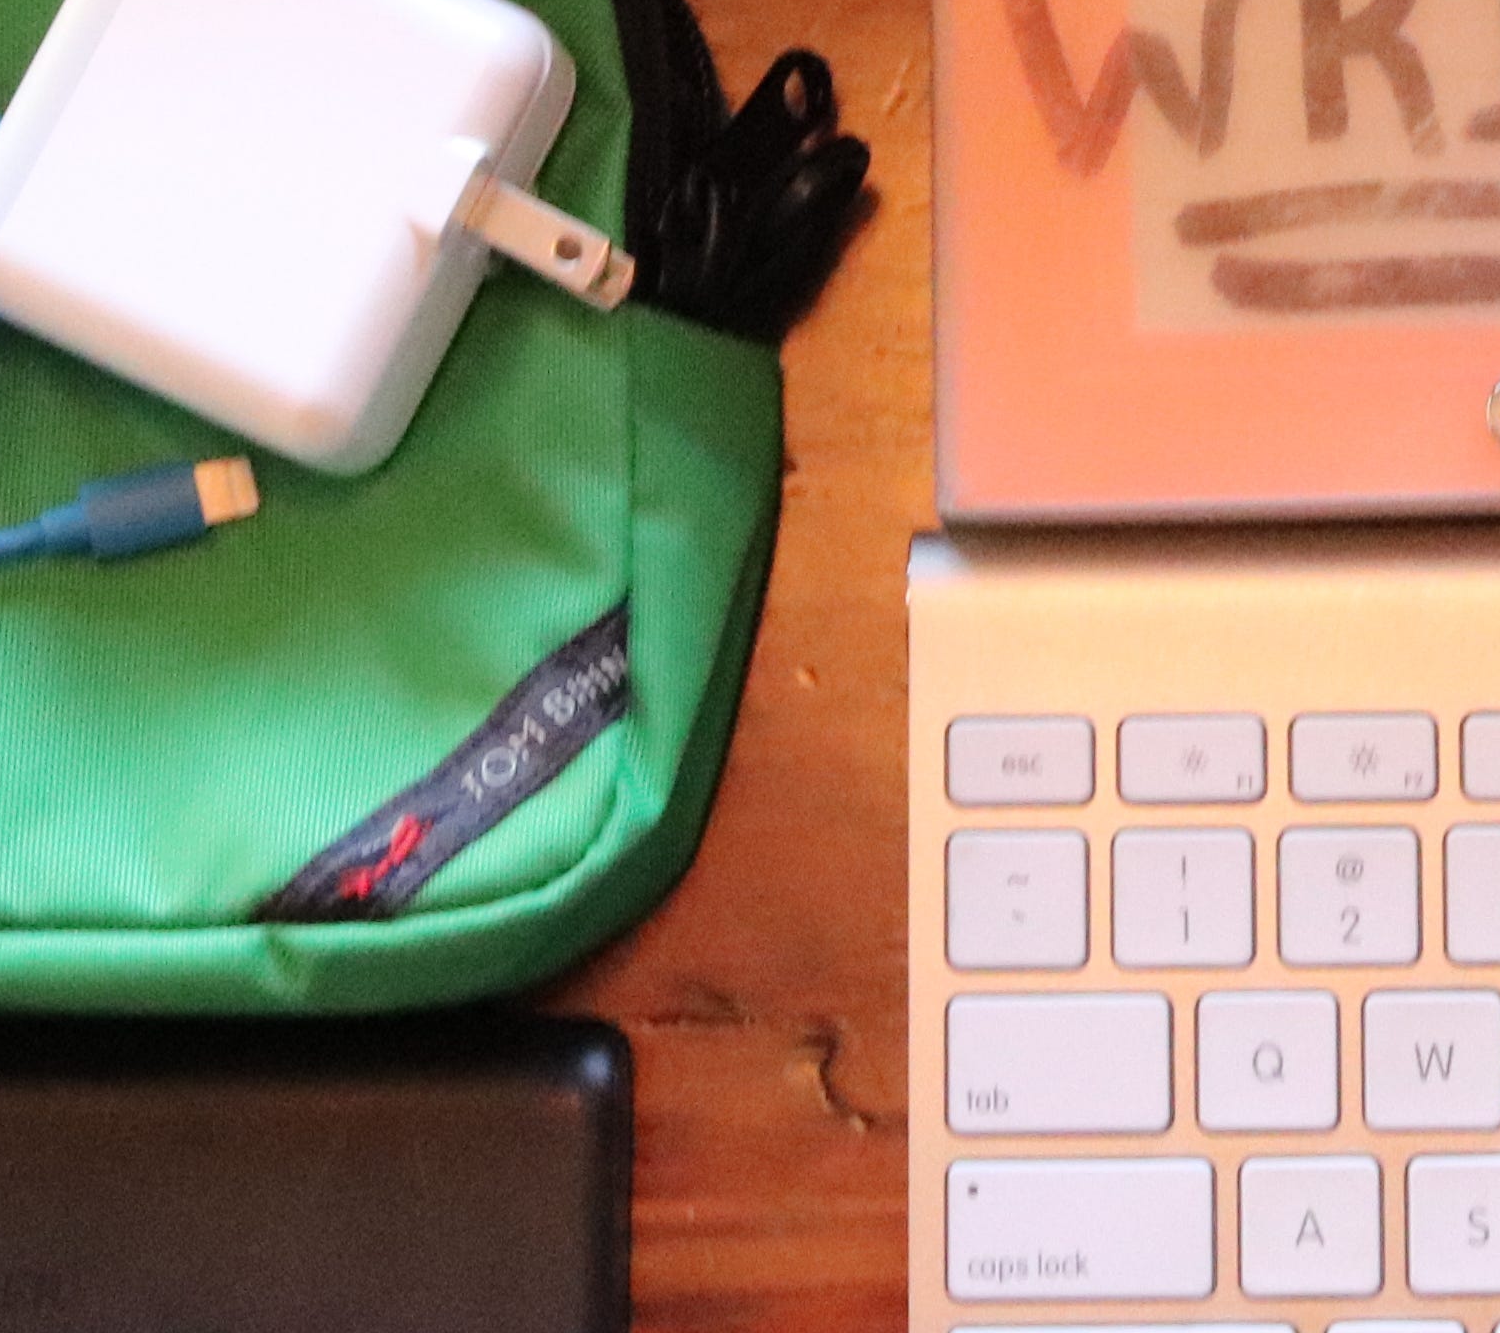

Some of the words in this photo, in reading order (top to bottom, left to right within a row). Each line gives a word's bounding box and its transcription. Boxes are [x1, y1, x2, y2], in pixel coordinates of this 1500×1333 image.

[1181, 907, 1190, 944] 1
[1339, 906, 1361, 944] 2
[1251, 1043, 1285, 1080] Q
[1414, 1042, 1455, 1082] W
[966, 1086, 1010, 1113] tab
[1294, 1208, 1325, 1248] A
[1467, 1208, 1491, 1245] S
[967, 1258, 1029, 1284] caps
[1037, 1251, 1087, 1277] lock
